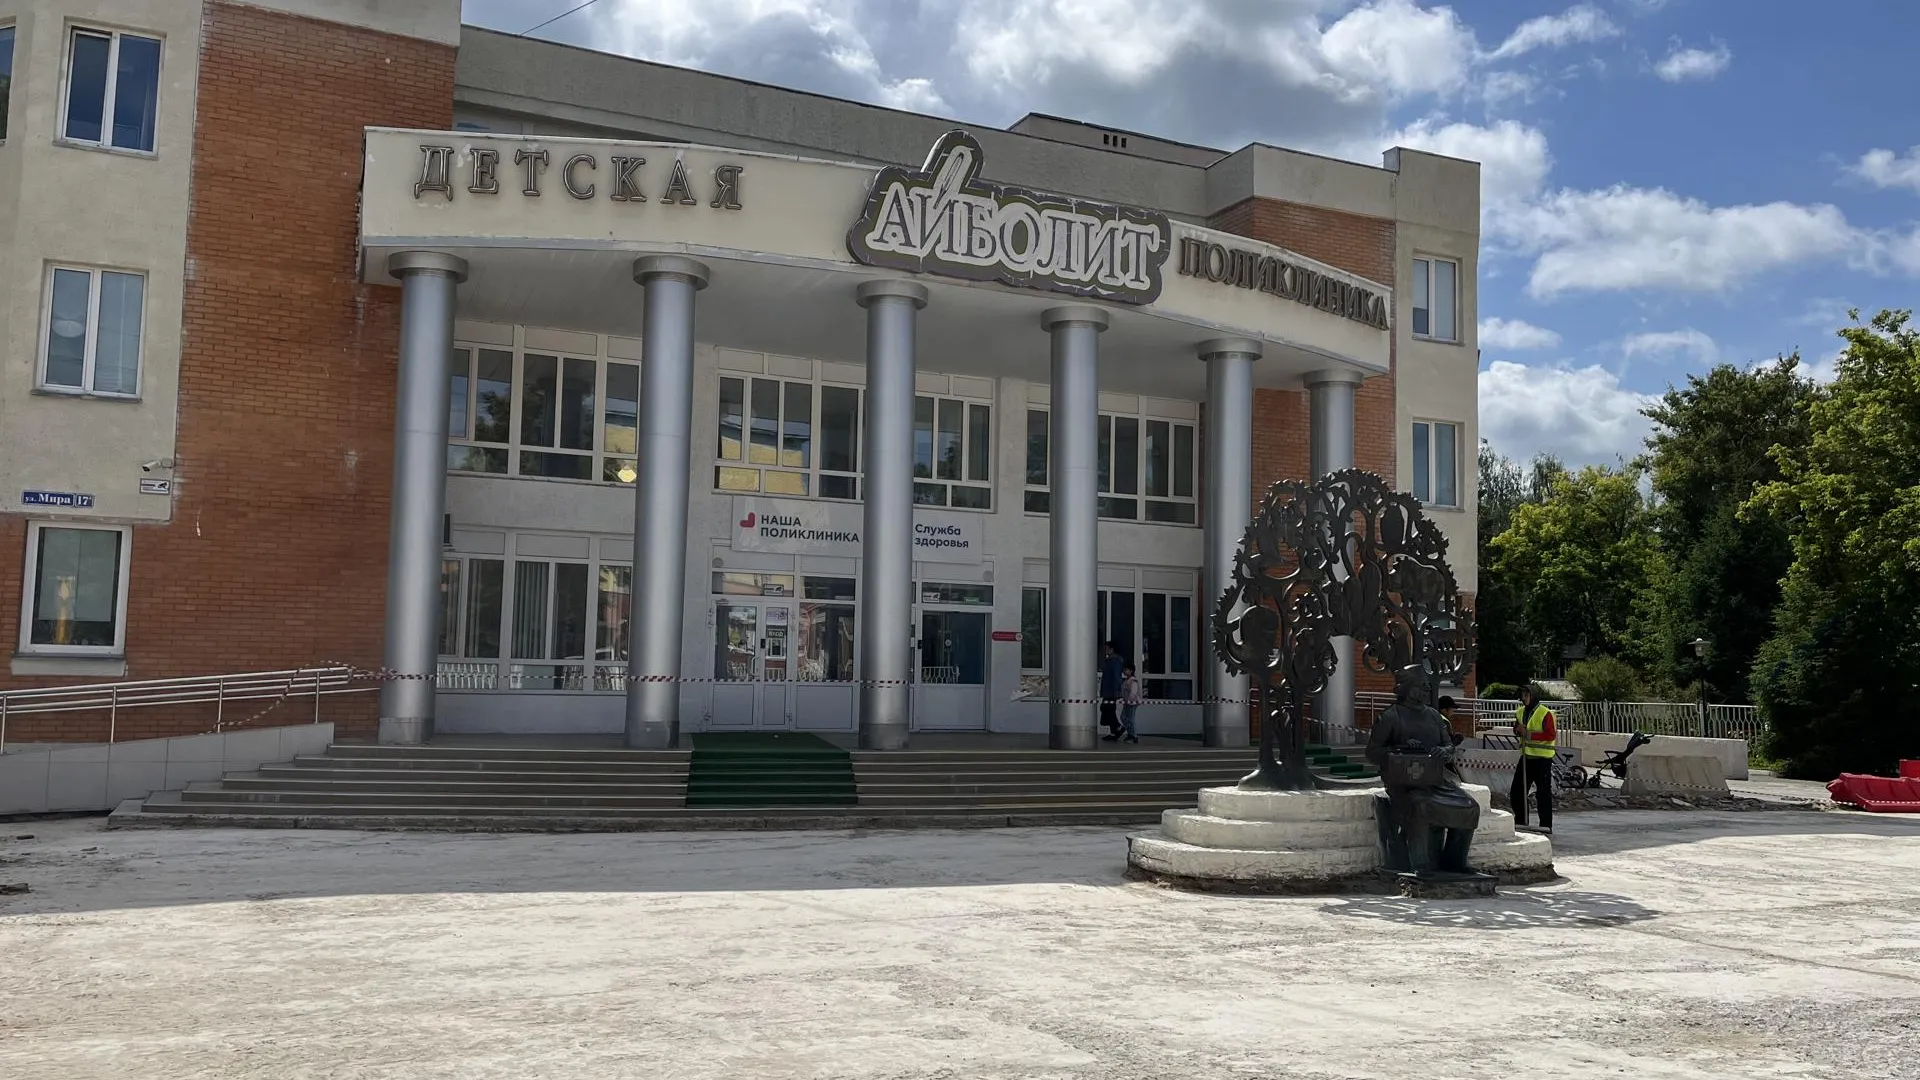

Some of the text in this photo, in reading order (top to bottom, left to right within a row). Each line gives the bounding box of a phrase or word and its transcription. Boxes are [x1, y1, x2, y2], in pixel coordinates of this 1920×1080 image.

[413, 144, 744, 211] ДЕТСКАЯ
[872, 147, 1160, 288] АЙБОЛИТ
[1178, 236, 1390, 331] ПОЛИКЛИНИКА
[39, 493, 71, 505] Мира
[761, 514, 802, 527] НАША
[760, 527, 860, 542] ПОЛИКЛИНИКА
[914, 524, 961, 537] Служба
[914, 537, 969, 549] здоровья
